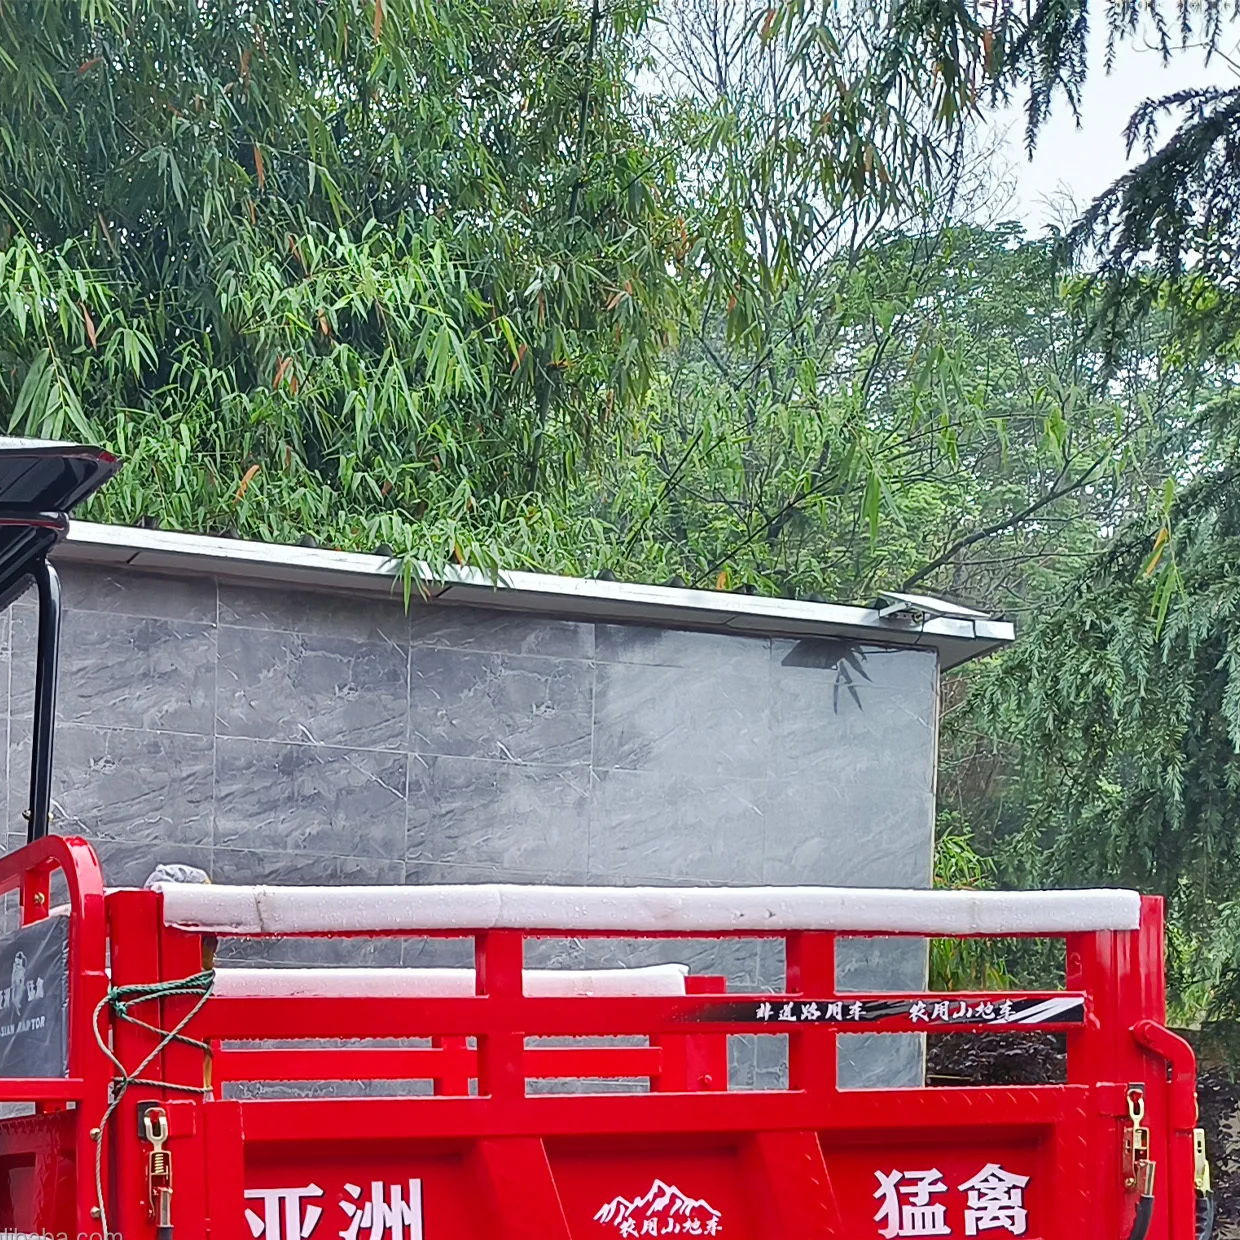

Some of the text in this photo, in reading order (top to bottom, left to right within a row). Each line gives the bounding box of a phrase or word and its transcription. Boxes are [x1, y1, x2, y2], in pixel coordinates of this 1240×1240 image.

[909, 999, 1016, 1023] 农用山地车
[873, 1163, 1031, 1240] 猛禽
